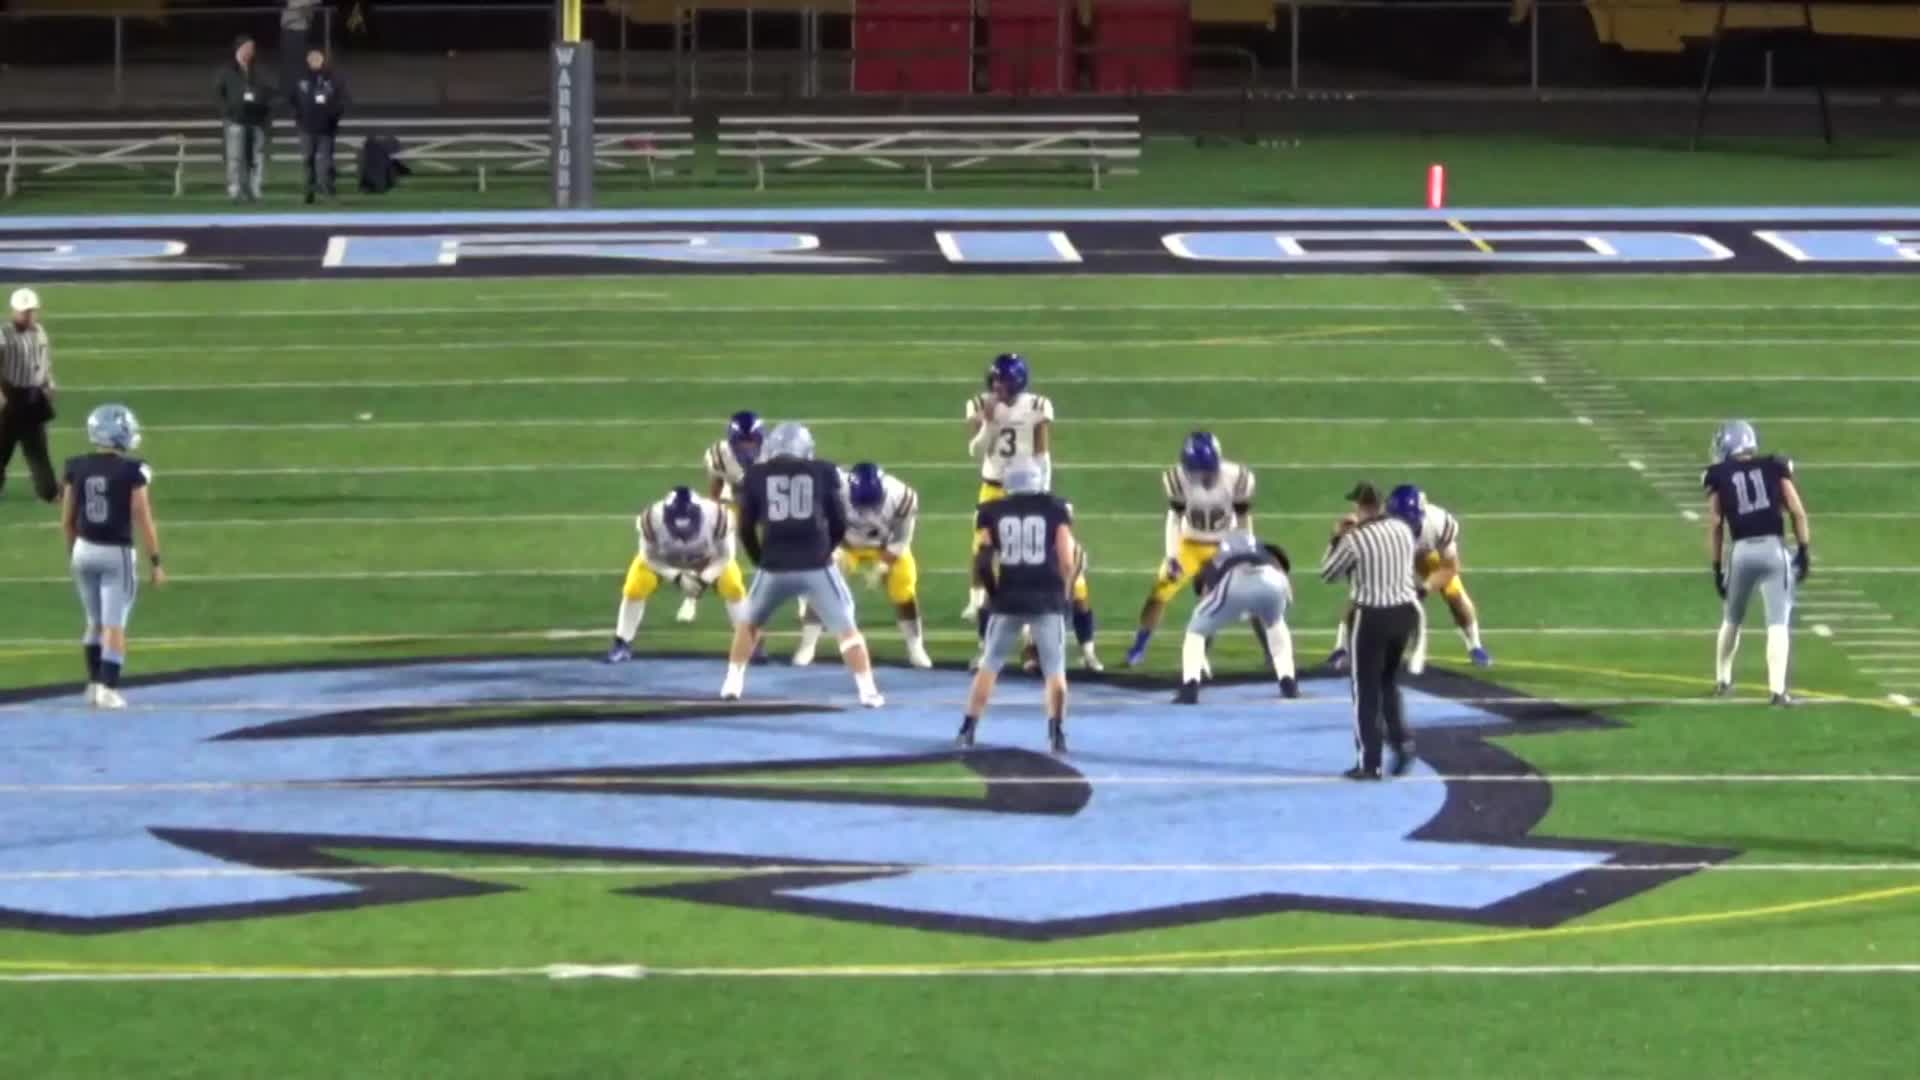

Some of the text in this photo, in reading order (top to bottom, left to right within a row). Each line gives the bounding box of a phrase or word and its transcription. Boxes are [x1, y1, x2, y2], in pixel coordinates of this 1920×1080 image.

[1000, 426, 1018, 458] 3
[765, 473, 815, 521] 50
[1731, 467, 1770, 515] 11
